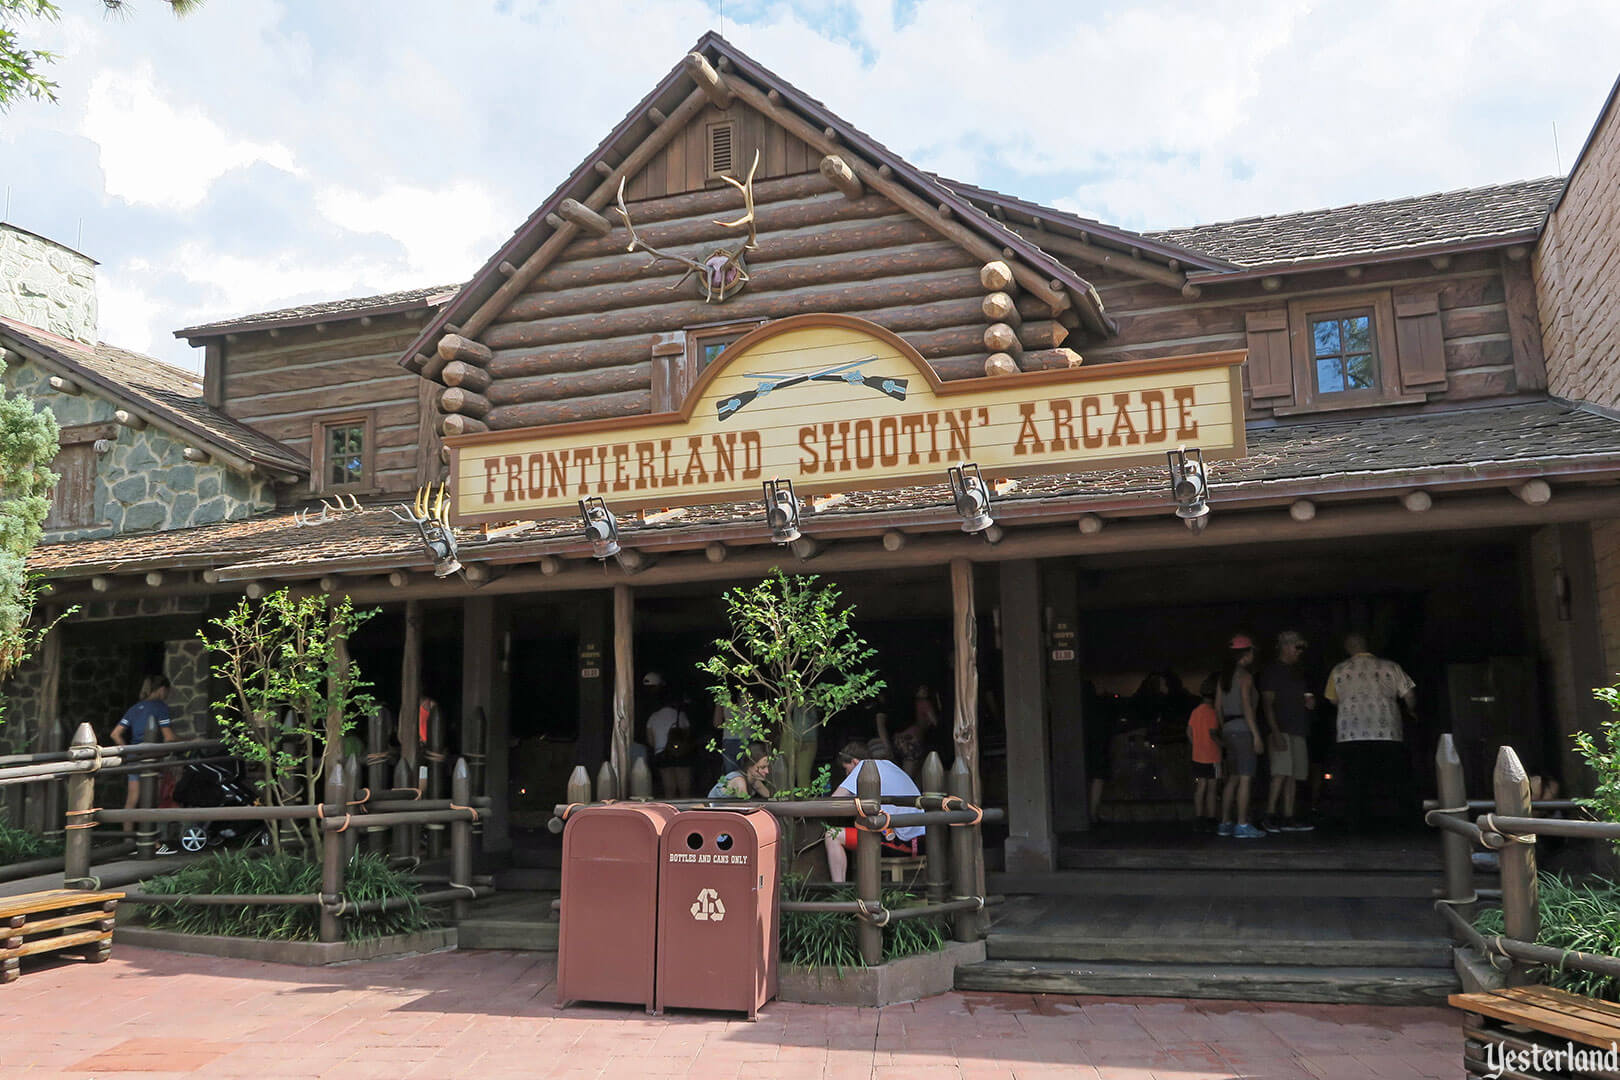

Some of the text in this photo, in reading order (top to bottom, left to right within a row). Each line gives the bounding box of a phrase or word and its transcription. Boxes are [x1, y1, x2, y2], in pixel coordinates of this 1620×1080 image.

[483, 386, 1199, 505] FRONTIERLAND SHOOTIN' ARCADE
[669, 853, 748, 864] BOTTLES AND CANS ONLY
